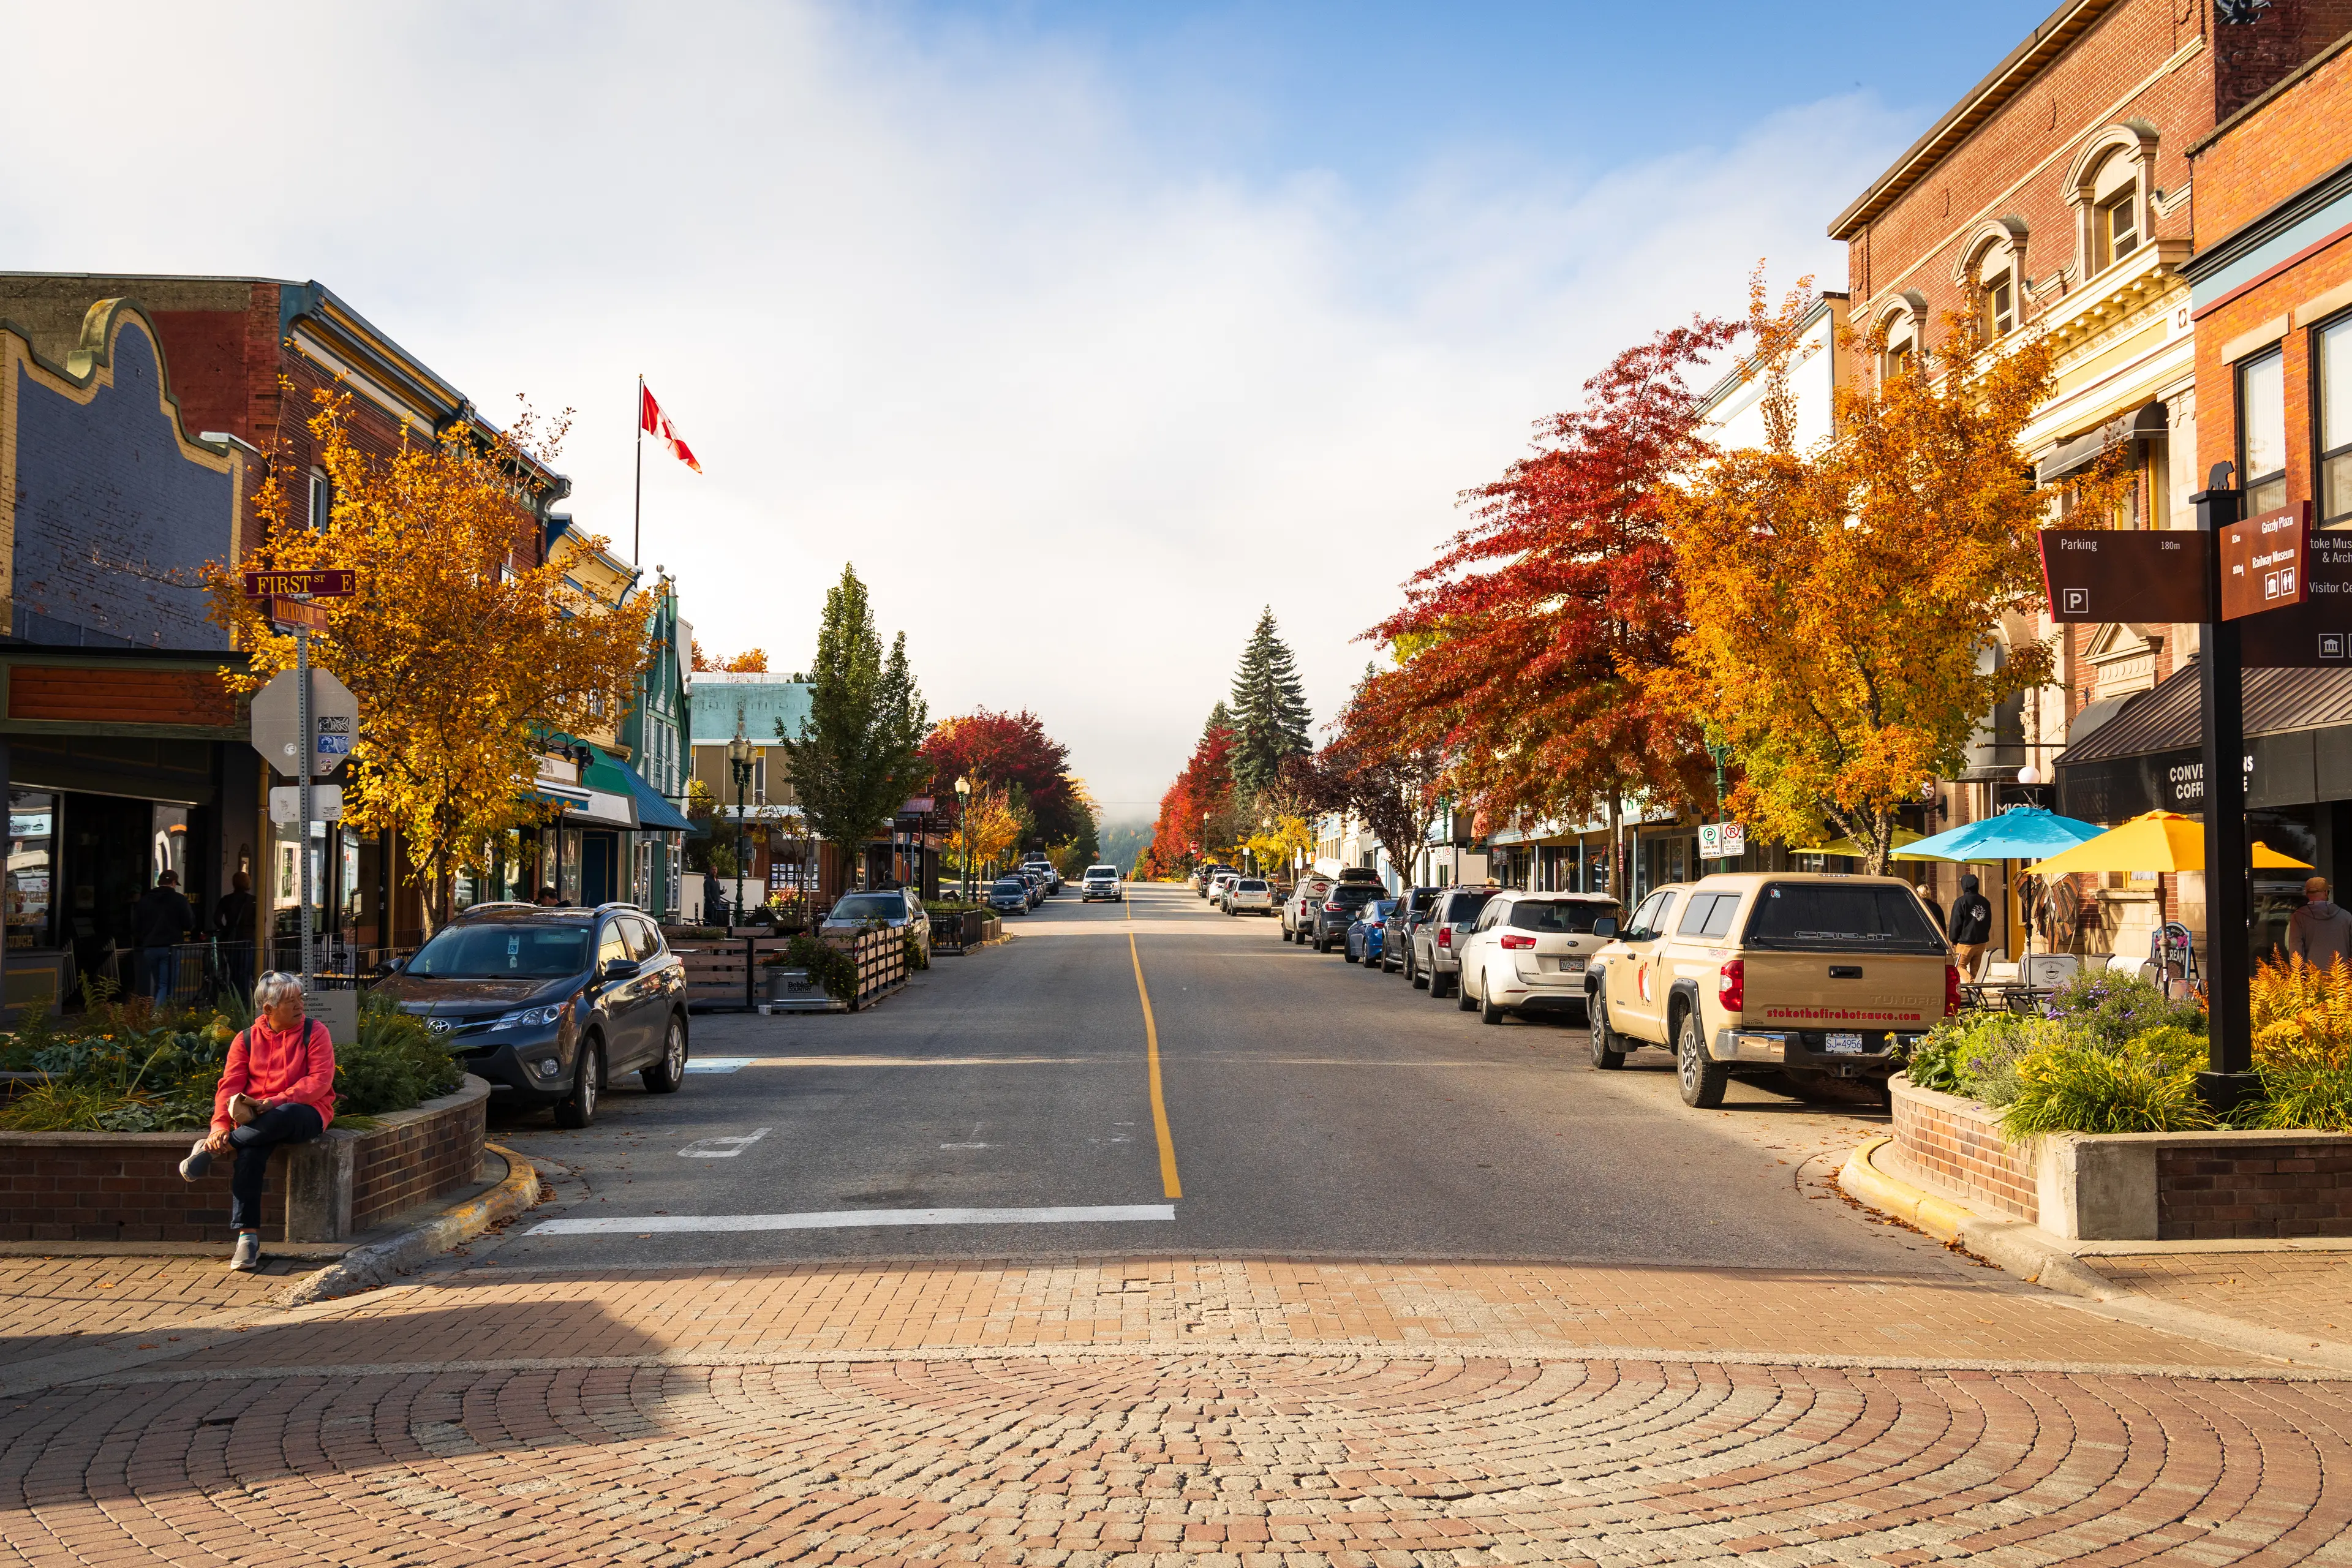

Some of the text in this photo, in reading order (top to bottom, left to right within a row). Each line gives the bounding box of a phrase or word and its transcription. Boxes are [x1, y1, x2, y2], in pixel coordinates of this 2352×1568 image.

[2262, 516, 2294, 534] Grizzly Plaza
[2061, 539, 2180, 552] Parking 180m
[2310, 538, 2352, 549] toke Mus
[2252, 549, 2294, 568] Railway Museum
[2323, 552, 2352, 563] & Arch
[257, 575, 311, 594] FIRST
[341, 575, 352, 592] E
[2309, 582, 2352, 594] Visitor Ce
[276, 599, 325, 625] MACKENZIE AVE
[7, 935, 34, 948] UNCH
[1870, 995, 1940, 1006] TUNDRA
[1766, 1008, 1921, 1021] stokethefirehotsauce.com
